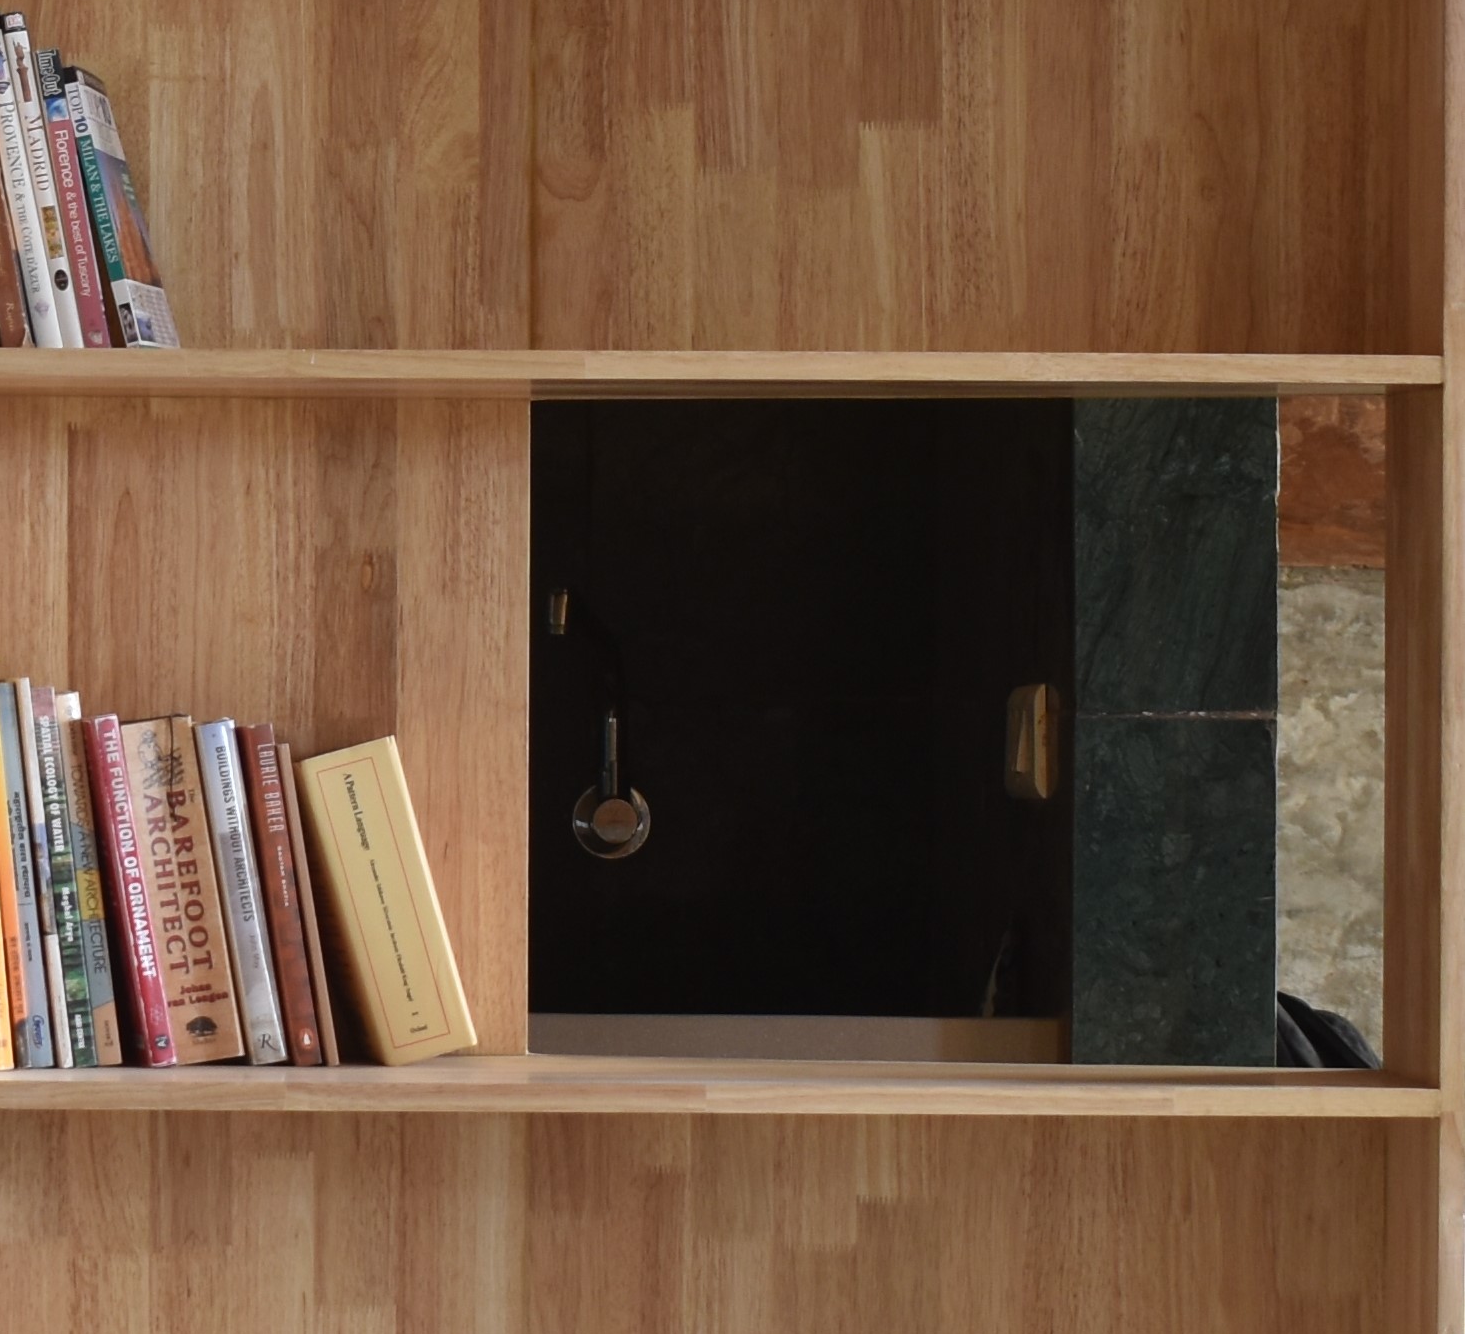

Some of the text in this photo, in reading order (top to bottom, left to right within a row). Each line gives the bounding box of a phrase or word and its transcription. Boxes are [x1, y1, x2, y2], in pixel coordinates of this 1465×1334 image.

[24, 113, 52, 192] MADRID
[53, 129, 93, 297] Florence & the best of Tuscany
[102, 728, 157, 978] THE FUNCTION OF ORNAMENT
[187, 788, 196, 803] The
[342, 772, 372, 851] A Pattern Language
[142, 791, 189, 976] ARCHITECT
[166, 788, 213, 972] BAREFOOT
